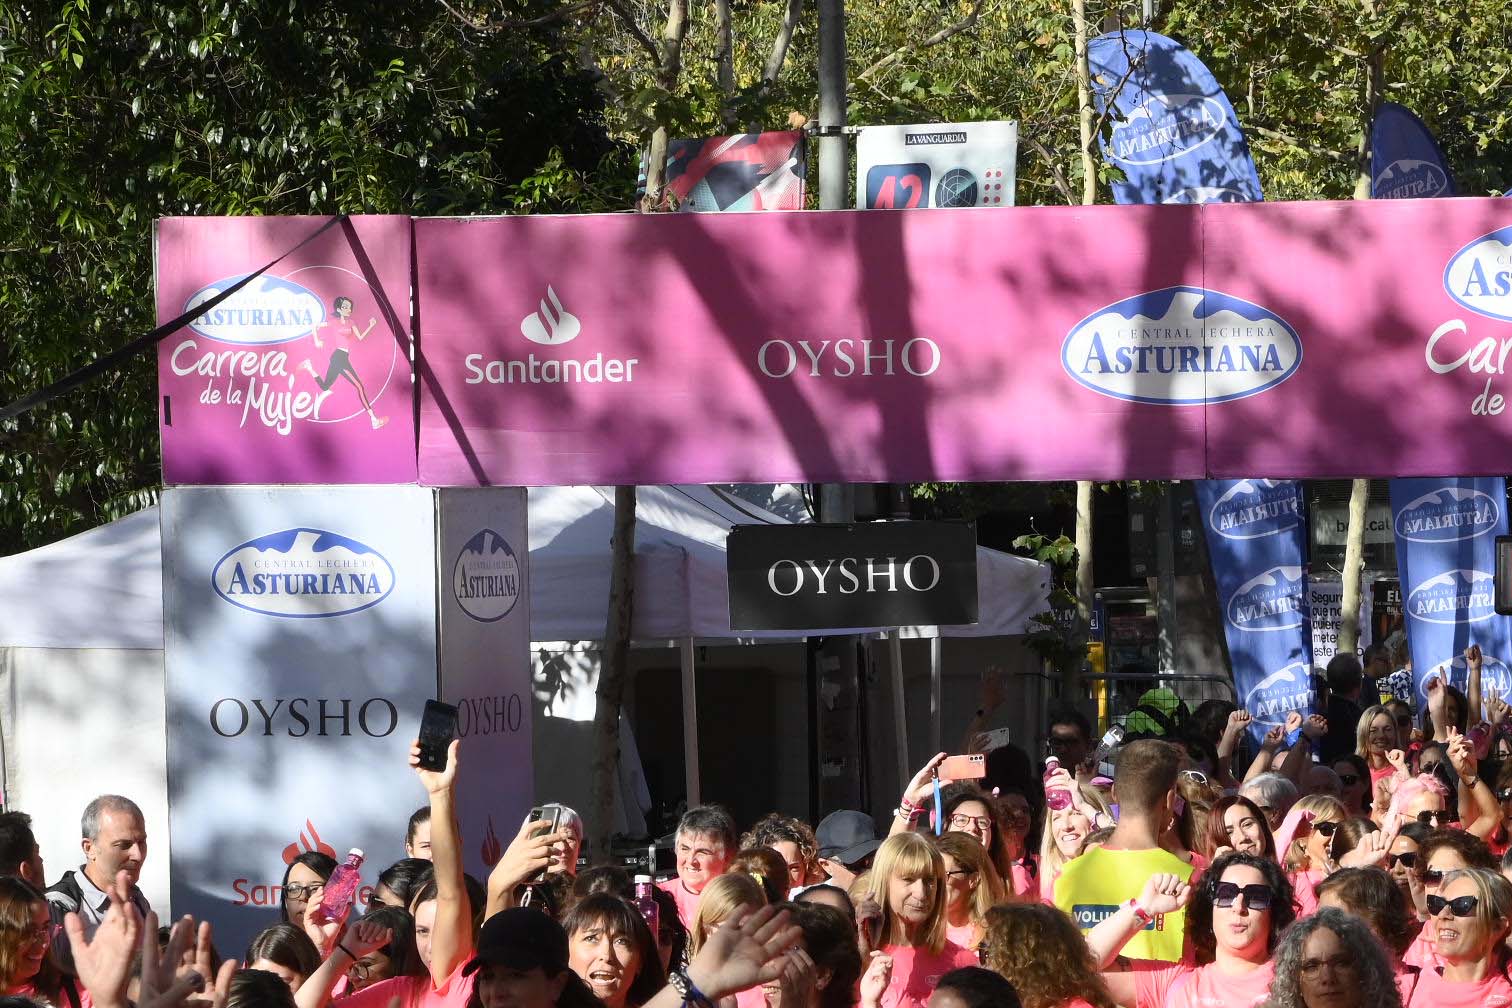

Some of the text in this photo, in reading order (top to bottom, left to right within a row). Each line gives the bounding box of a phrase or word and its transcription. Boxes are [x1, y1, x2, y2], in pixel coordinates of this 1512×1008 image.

[194, 299, 314, 327] ASTURIANA
[1118, 327, 1276, 338] CENTRAL LECHERA
[170, 340, 288, 376] Carrera
[465, 353, 639, 384] Santander
[757, 337, 942, 379] OYSHO
[1081, 331, 1284, 374] ASTURIANA
[200, 374, 333, 436] de la Mujer
[1471, 377, 1506, 416] de
[226, 561, 382, 595] ASTURIANA
[254, 559, 313, 568] CENTRAL
[768, 555, 941, 597] OYSHO
[458, 564, 517, 599] ASTURIANA
[1312, 591, 1343, 604] Segur
[209, 698, 398, 737] OYSHO
[458, 694, 522, 738] OYSHO
[1074, 910, 1118, 923] VOLU
